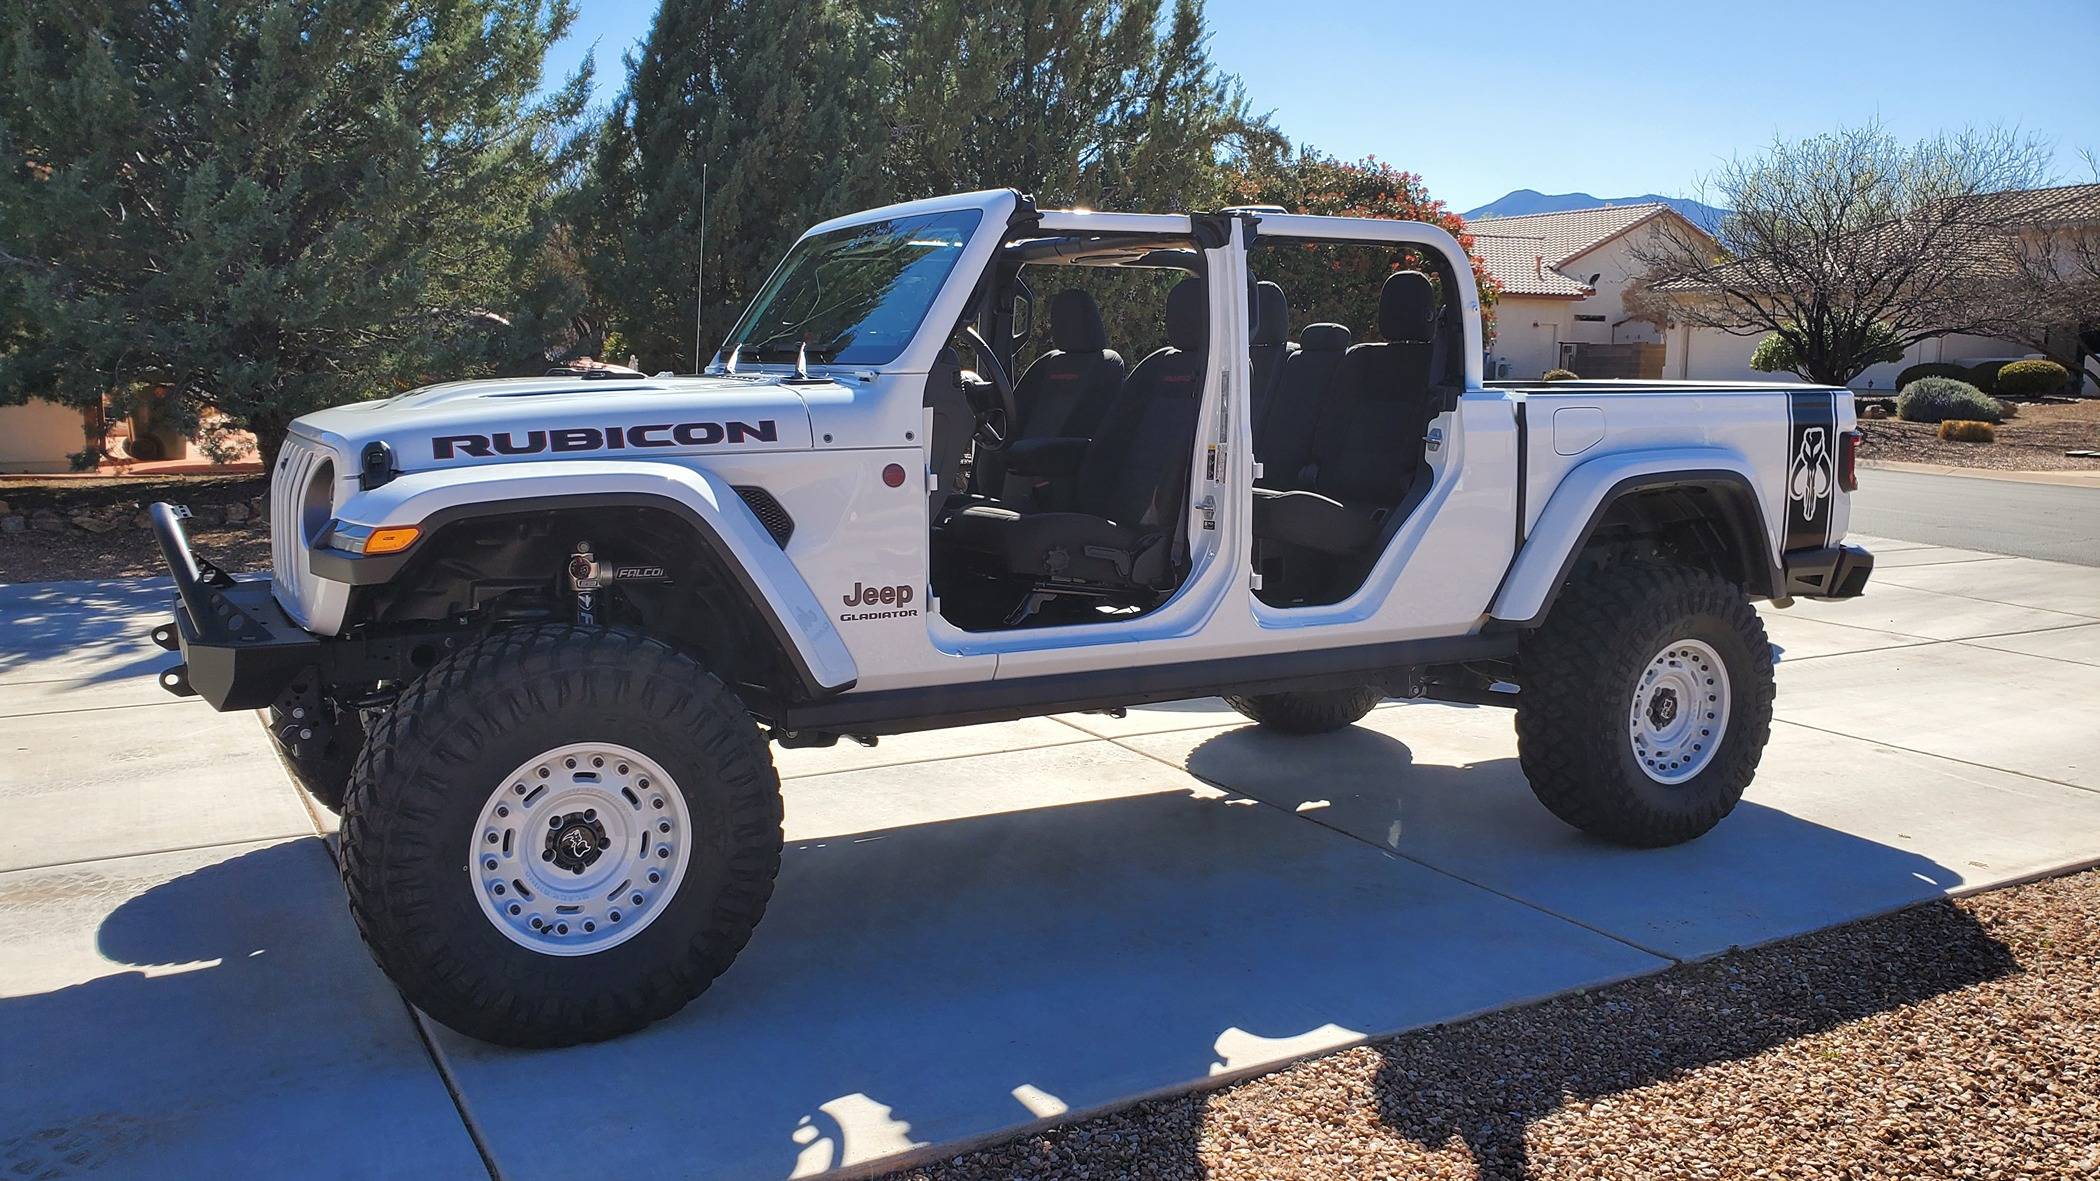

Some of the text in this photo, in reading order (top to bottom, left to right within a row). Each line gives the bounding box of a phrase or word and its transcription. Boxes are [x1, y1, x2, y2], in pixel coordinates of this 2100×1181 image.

[431, 419, 778, 460] RUBICON
[618, 568, 664, 578] FALCO
[843, 582, 914, 608] Jeep
[840, 609, 918, 622] GLADIATOR
